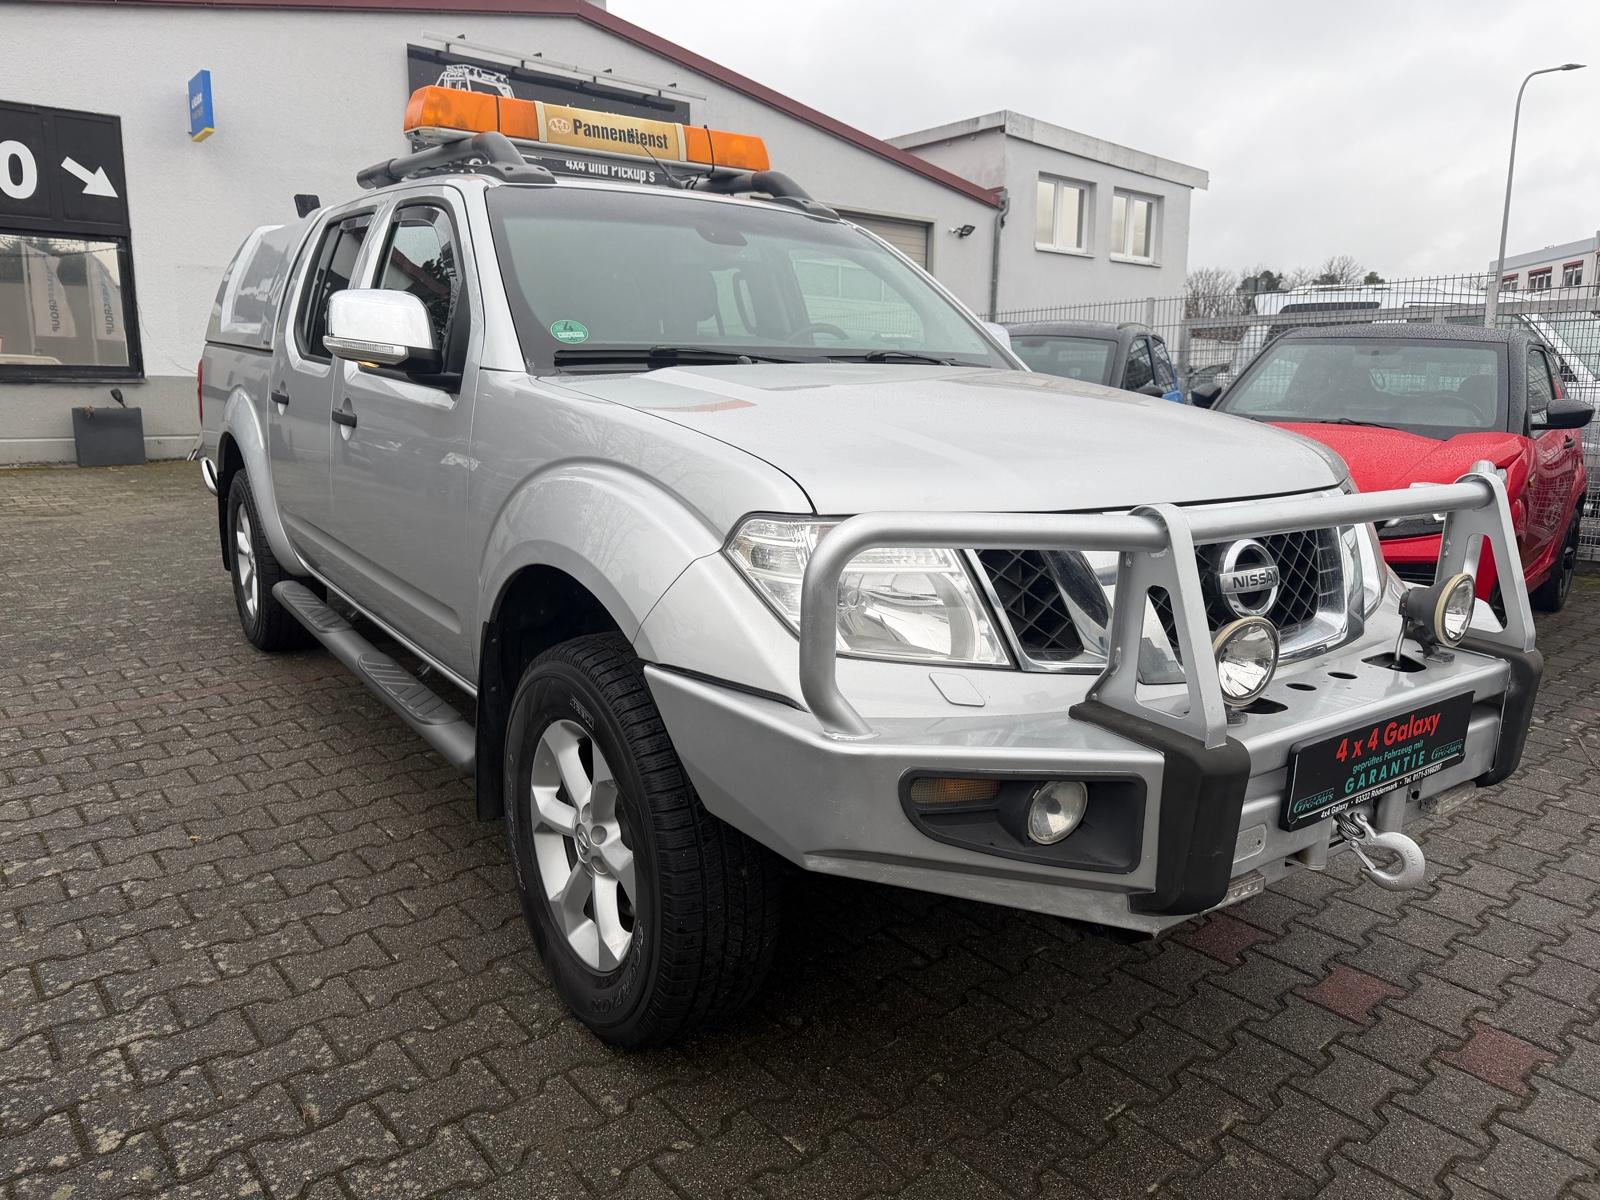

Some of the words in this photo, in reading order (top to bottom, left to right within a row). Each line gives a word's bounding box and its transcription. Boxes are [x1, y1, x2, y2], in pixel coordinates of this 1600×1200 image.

[572, 119, 668, 149] Pannendienst
[1232, 570, 1278, 589] NISSAN
[1335, 738, 1348, 762] 4
[1352, 740, 1363, 758] x
[1367, 727, 1379, 751] 4
[1383, 712, 1441, 746] Galaxy
[1344, 751, 1425, 794] GARANTIE
[1352, 754, 1383, 775] geprüftes
[1384, 743, 1413, 761] Fahrzeug
[1413, 740, 1424, 752] mit
[1320, 806, 1331, 818] 4x4
[1331, 802, 1349, 814] Galaxy
[1371, 782, 1398, 798] Rödermark
